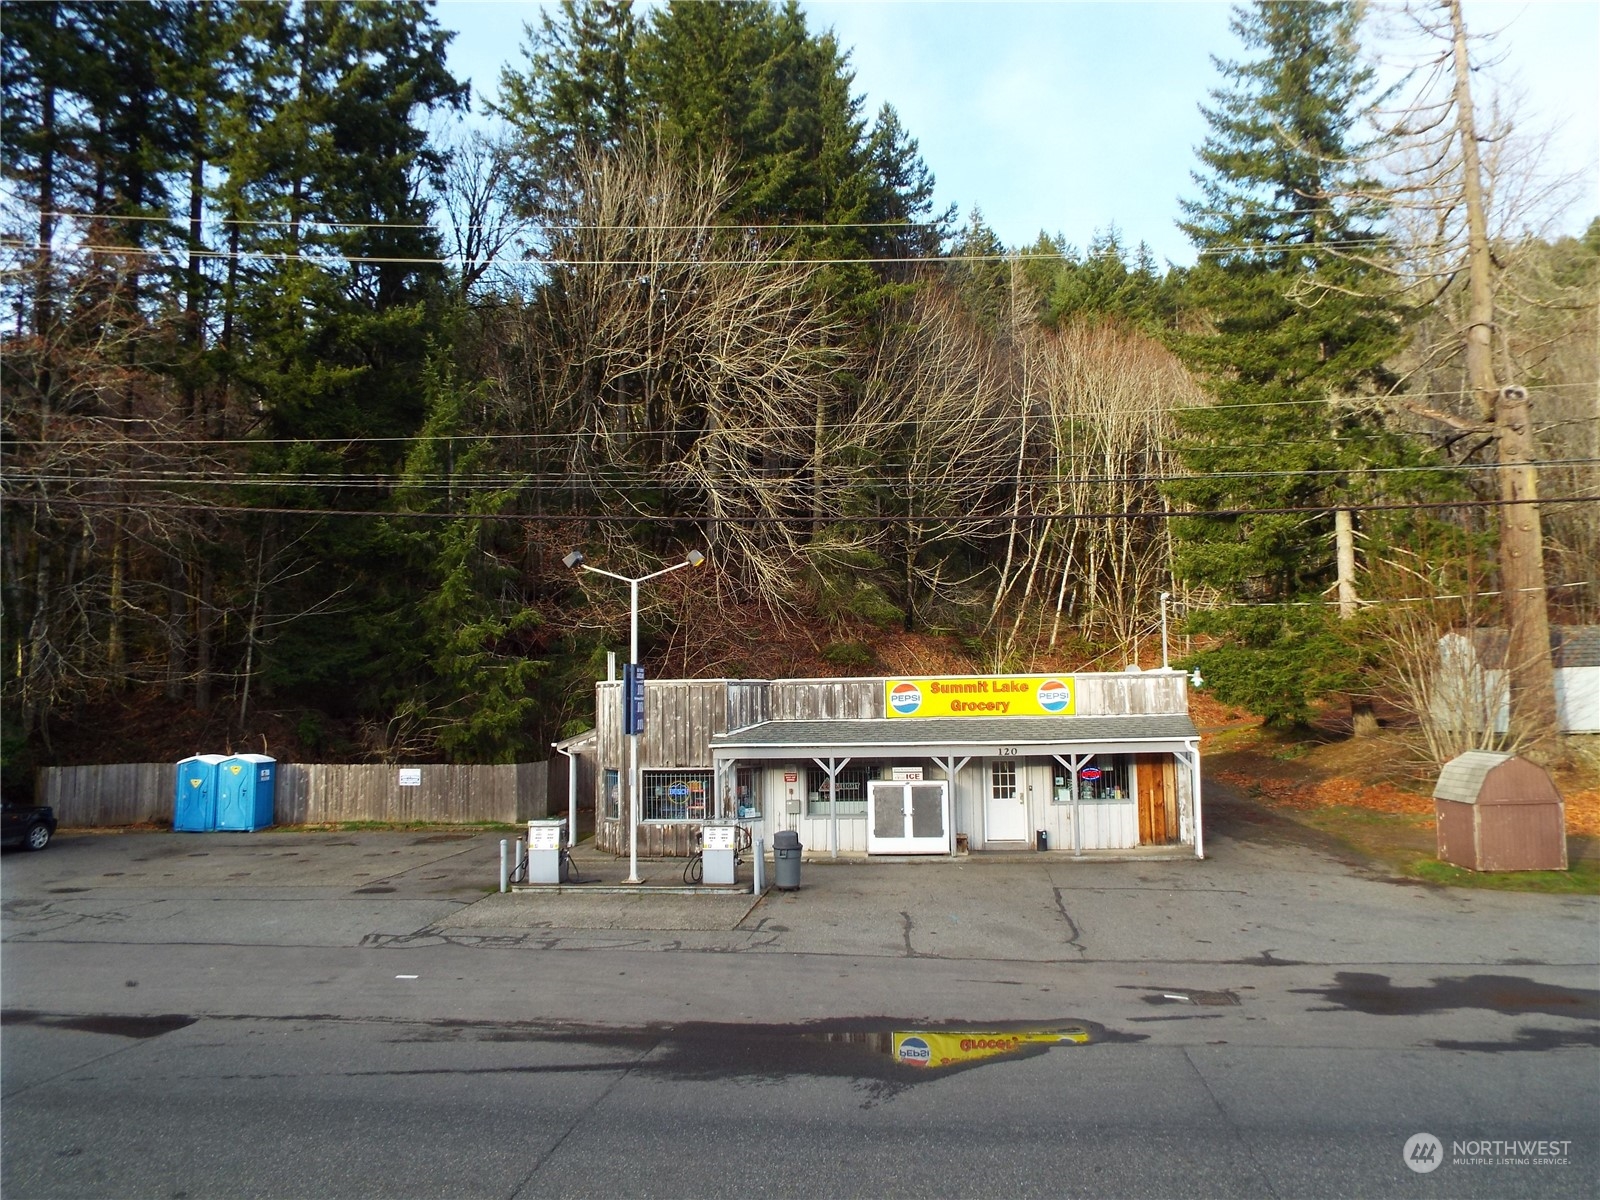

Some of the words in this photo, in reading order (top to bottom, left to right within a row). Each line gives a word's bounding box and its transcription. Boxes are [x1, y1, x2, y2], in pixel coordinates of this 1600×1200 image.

[930, 681, 988, 694] Summit
[992, 681, 1029, 693] Lake
[891, 694, 921, 702] PEPSI
[1039, 692, 1069, 700] PEPSI
[950, 699, 1011, 713] Grocery
[998, 747, 1018, 756] 120
